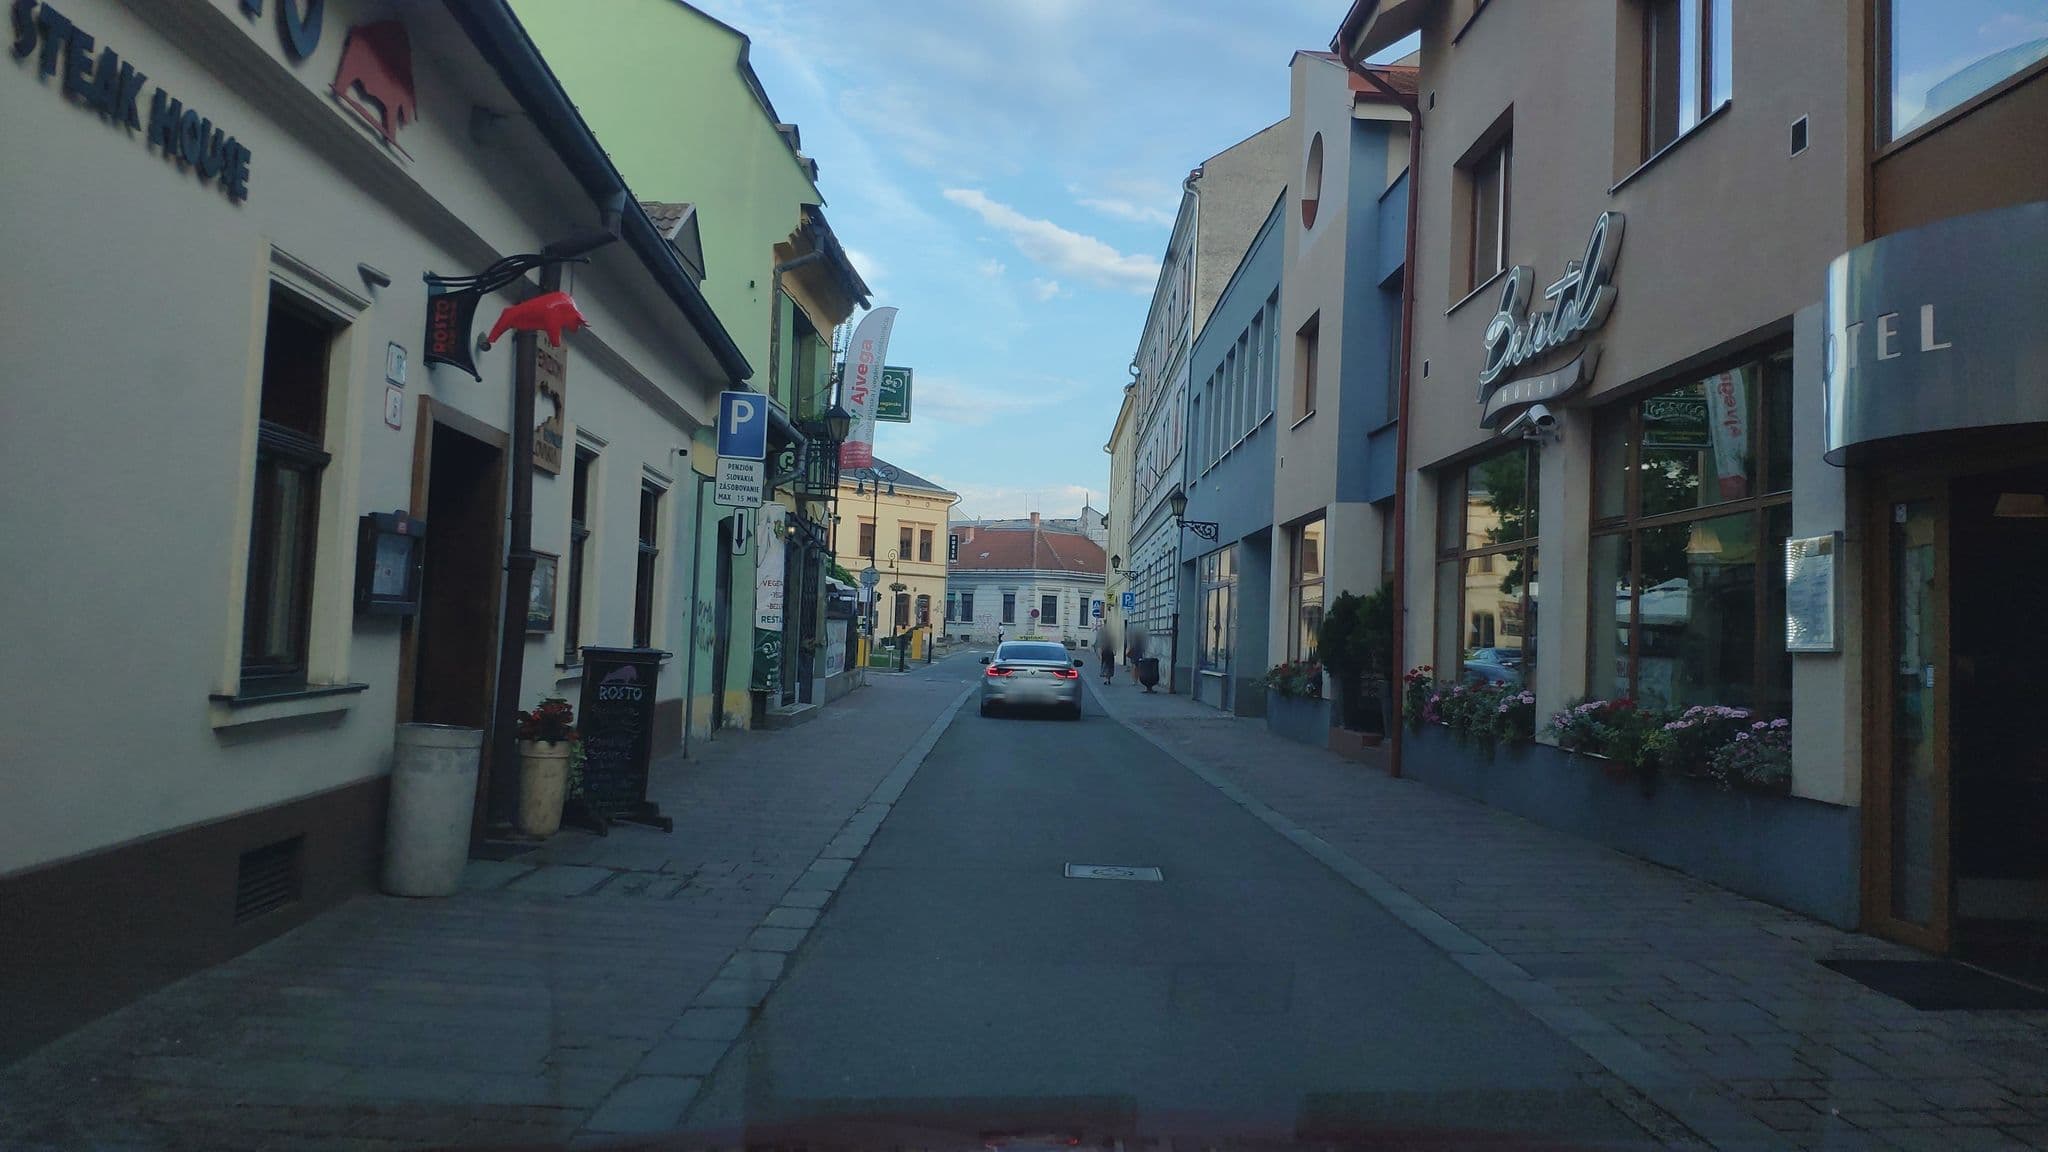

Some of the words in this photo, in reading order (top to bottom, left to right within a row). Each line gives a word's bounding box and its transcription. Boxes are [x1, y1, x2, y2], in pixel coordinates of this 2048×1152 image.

[11, 0, 148, 132] STEAK
[148, 86, 251, 202] HOUSE
[1479, 210, 1616, 386] Bristol
[851, 339, 875, 406] Ajvega
[730, 399, 755, 435] P
[726, 473, 754, 483] SLOVAKIA
[718, 493, 731, 501] MAX
[599, 686, 643, 700] ROSTO
